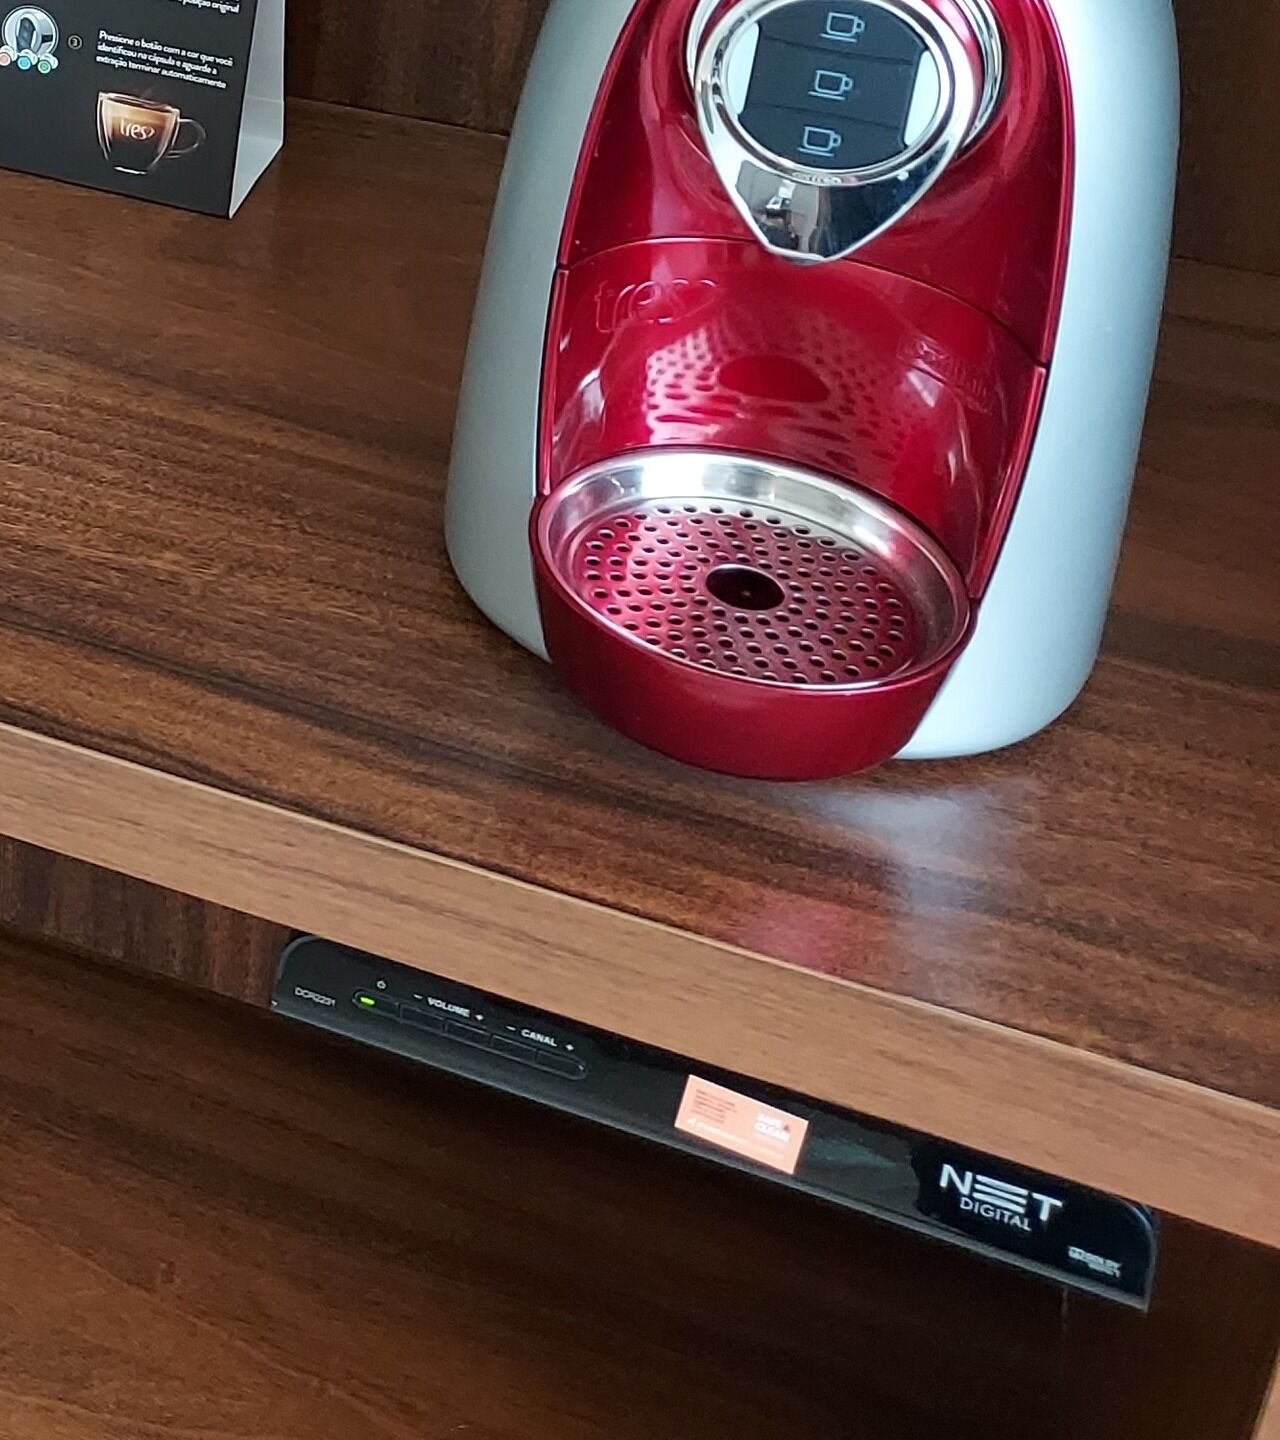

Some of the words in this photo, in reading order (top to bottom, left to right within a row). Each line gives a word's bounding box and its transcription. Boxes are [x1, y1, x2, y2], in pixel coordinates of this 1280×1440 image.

[97, 41, 137, 58] identificou
[147, 52, 175, 67] cápsula
[181, 62, 212, 75] aguarde
[99, 30, 135, 46] Pressione
[141, 38, 162, 51] botão
[163, 46, 181, 55] com
[186, 50, 200, 59] cor
[199, 53, 215, 64] que
[95, 55, 128, 68] extração
[128, 60, 161, 74] terminar
[161, 69, 227, 89] automaticamente
[427, 996, 471, 1018] VOLUME
[520, 1028, 558, 1047] CANAL
[940, 1162, 1064, 1222] NET
[959, 1196, 1032, 1232] DIGITAL
